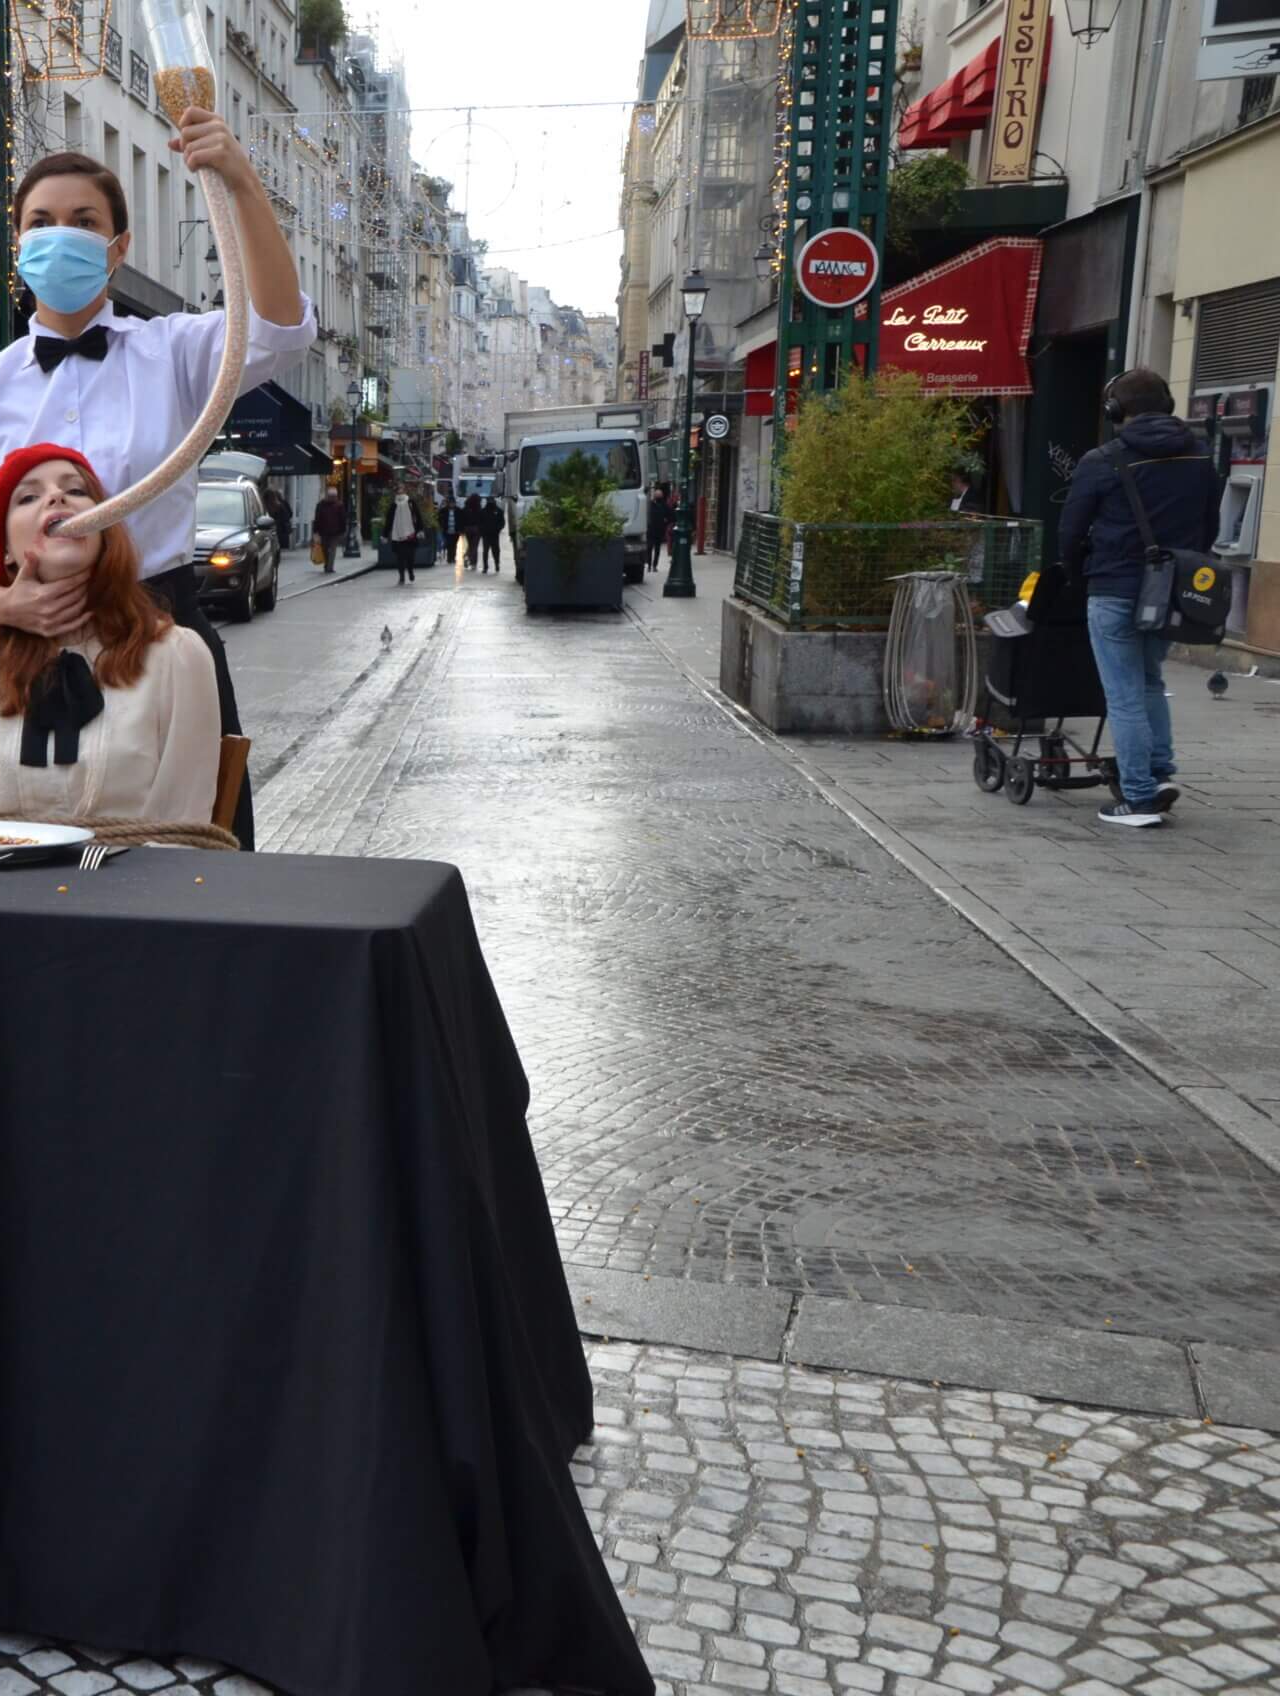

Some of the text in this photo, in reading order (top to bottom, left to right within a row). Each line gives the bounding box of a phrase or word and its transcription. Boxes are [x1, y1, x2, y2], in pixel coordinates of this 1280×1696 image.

[883, 305, 969, 326] Les Petits
[904, 332, 988, 352] Carreaux
[926, 372, 978, 383] Brasserie
